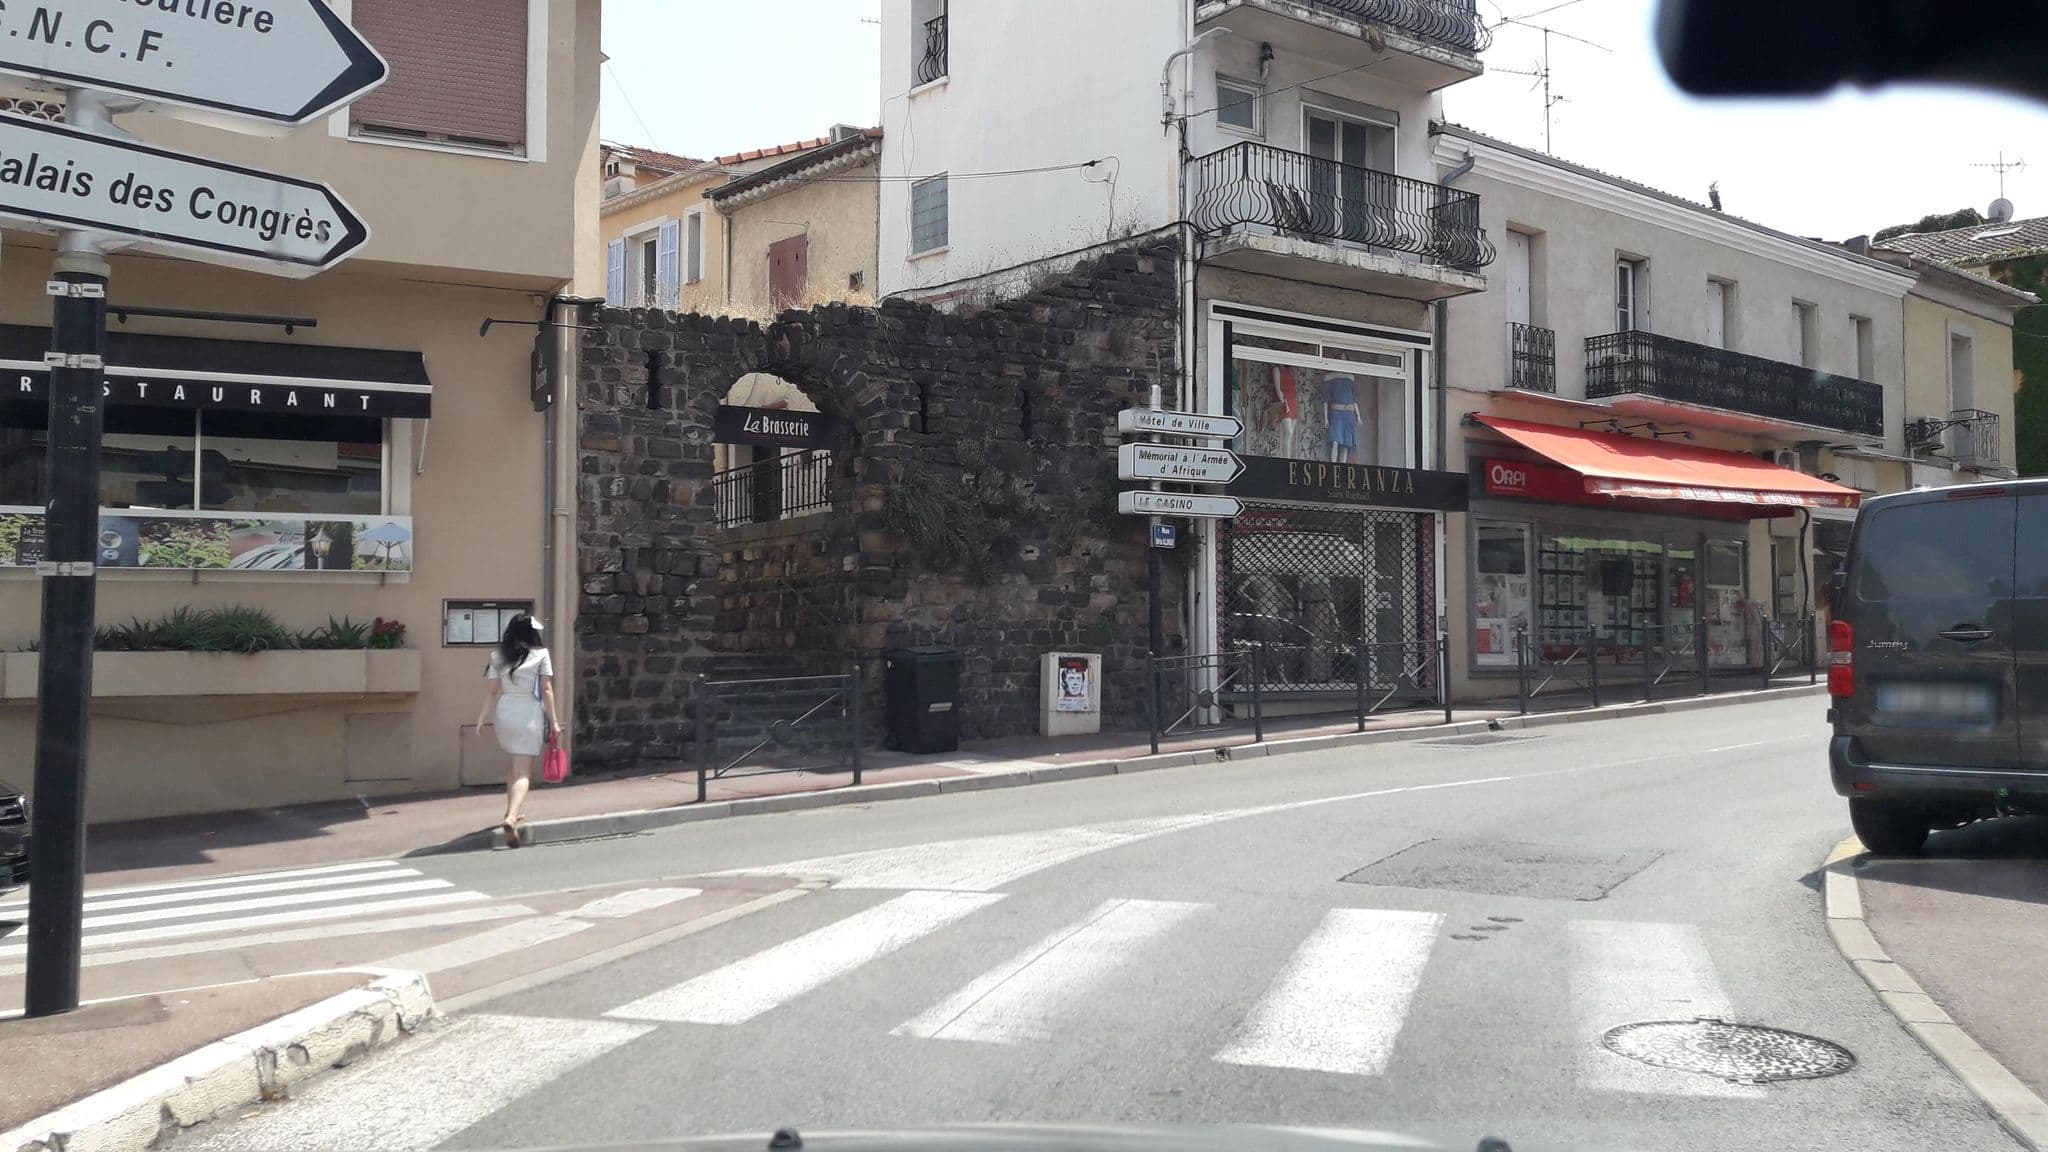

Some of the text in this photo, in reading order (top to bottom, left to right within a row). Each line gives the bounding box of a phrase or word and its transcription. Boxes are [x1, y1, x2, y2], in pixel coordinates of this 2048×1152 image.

[119, 0, 274, 34] utière
[0, 152, 332, 242] alais des Congrès
[20, 376, 370, 411] RSTAURANT
[743, 411, 809, 437] La Brasserie
[1172, 418, 1183, 428] de
[1189, 419, 1210, 430] Ville
[1138, 449, 1178, 463] Mémorial
[1289, 461, 1414, 494] ESPERANZA
